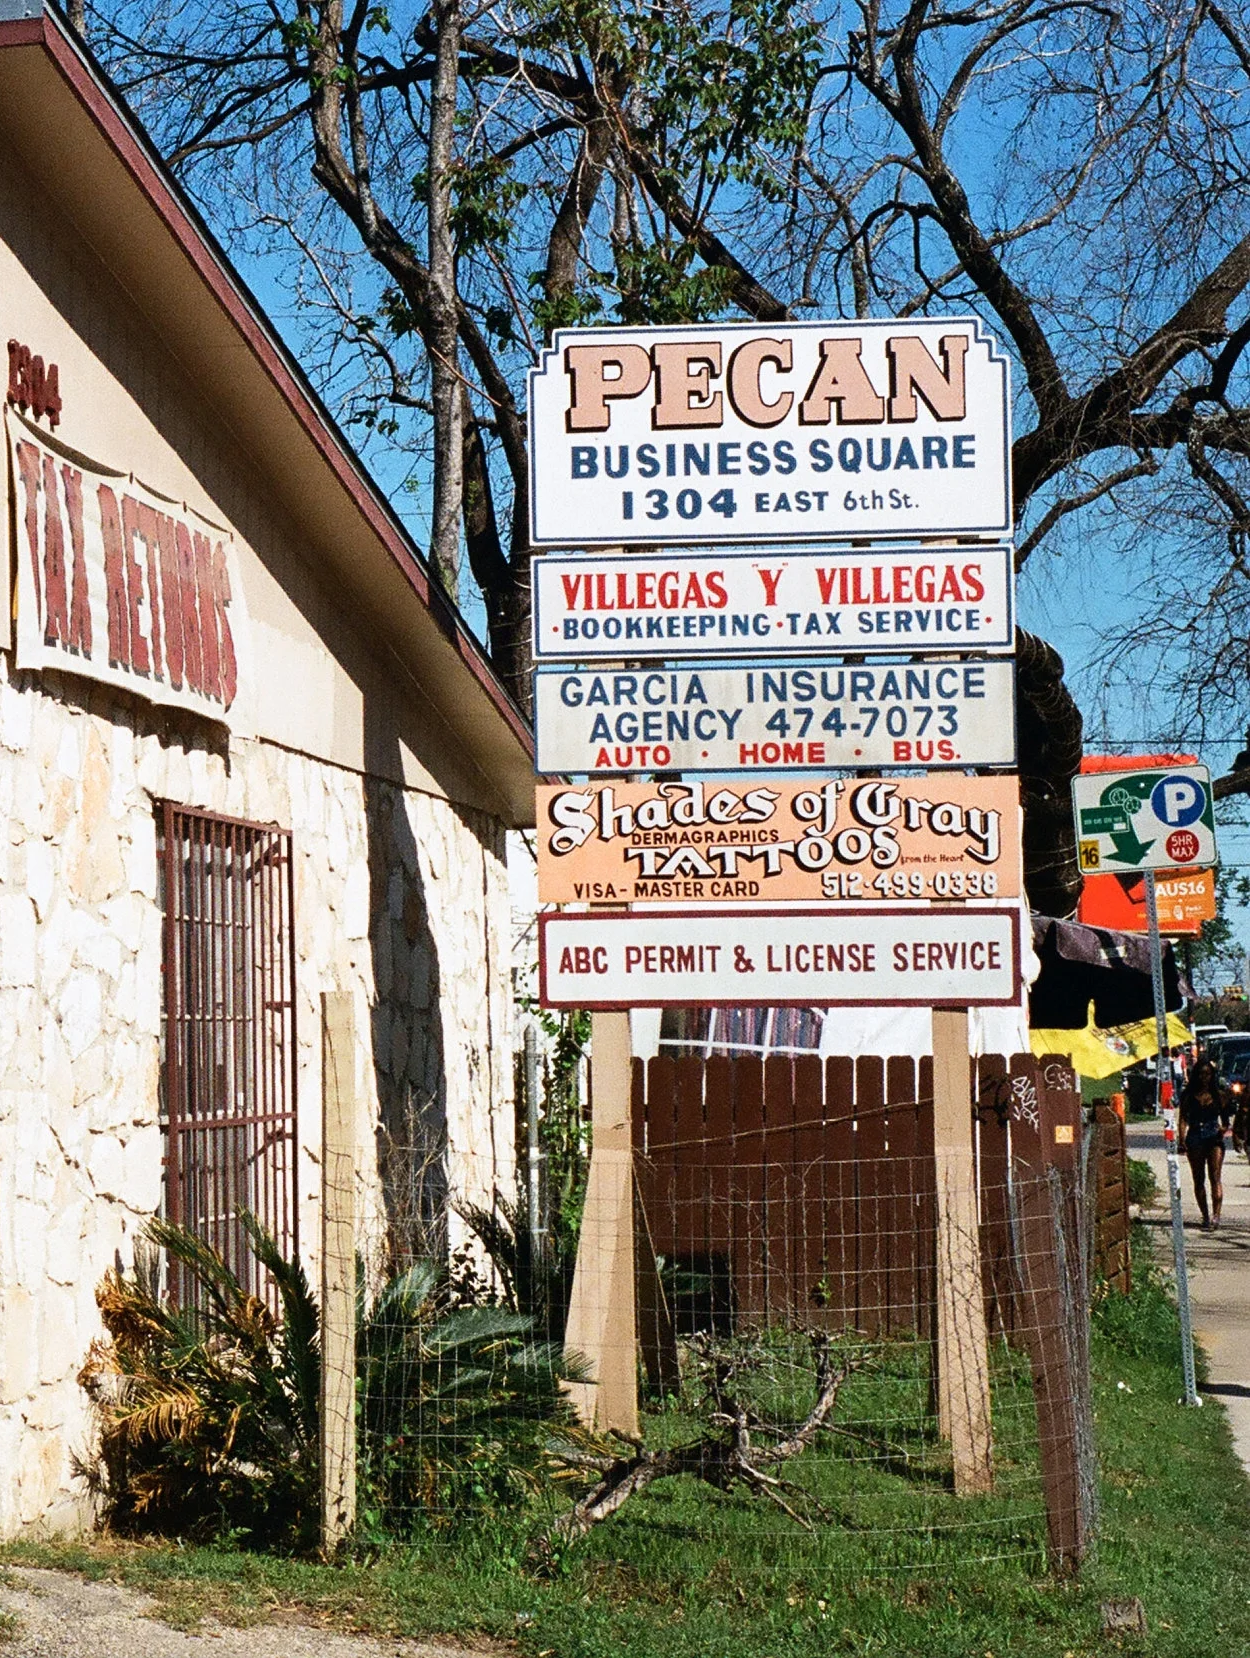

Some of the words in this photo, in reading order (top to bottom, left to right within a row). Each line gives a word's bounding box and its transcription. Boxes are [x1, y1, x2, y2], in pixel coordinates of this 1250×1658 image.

[564, 334, 970, 433] PECAN
[570, 440, 797, 480] BUSINESS
[808, 434, 976, 475] SQUARE
[622, 487, 738, 520] 1304
[755, 491, 830, 513] EAST
[843, 489, 883, 511] 6th
[889, 489, 919, 510] St.
[16, 437, 93, 661] TAX
[97, 482, 239, 714] RETURNS
[561, 569, 729, 611] VILLEGAS
[816, 563, 986, 605] VILLEGAS
[563, 613, 771, 640] BOOKKEEPING
[785, 611, 843, 636] TAX
[858, 608, 980, 633] SERVICE
[559, 673, 708, 707] GARCIA
[746, 667, 986, 703] INSURANCE
[589, 708, 742, 743] AGENCY
[765, 704, 959, 738] 474-7073
[594, 745, 671, 767] AUTO
[739, 740, 826, 764] HOME
[893, 740, 962, 763] BUS.
[1163, 782, 1197, 824] P
[548, 781, 783, 857] Shades
[790, 779, 846, 838] of
[850, 781, 1002, 866] Gray
[631, 828, 779, 845] DERMAGRAPHICS
[624, 825, 901, 880] TATTOOS
[923, 854, 937, 863] the
[939, 853, 965, 862] Heart
[1081, 847, 1100, 866] 16
[1171, 845, 1196, 858] MAX
[633, 881, 704, 898] MASTER
[710, 880, 760, 897] CARD
[1155, 880, 1206, 898] AUS16
[559, 945, 608, 974] ABC
[625, 944, 721, 973] PERMIT
[734, 944, 756, 973] &
[767, 942, 877, 973] LICENSE
[893, 940, 1002, 971] SERVICE
